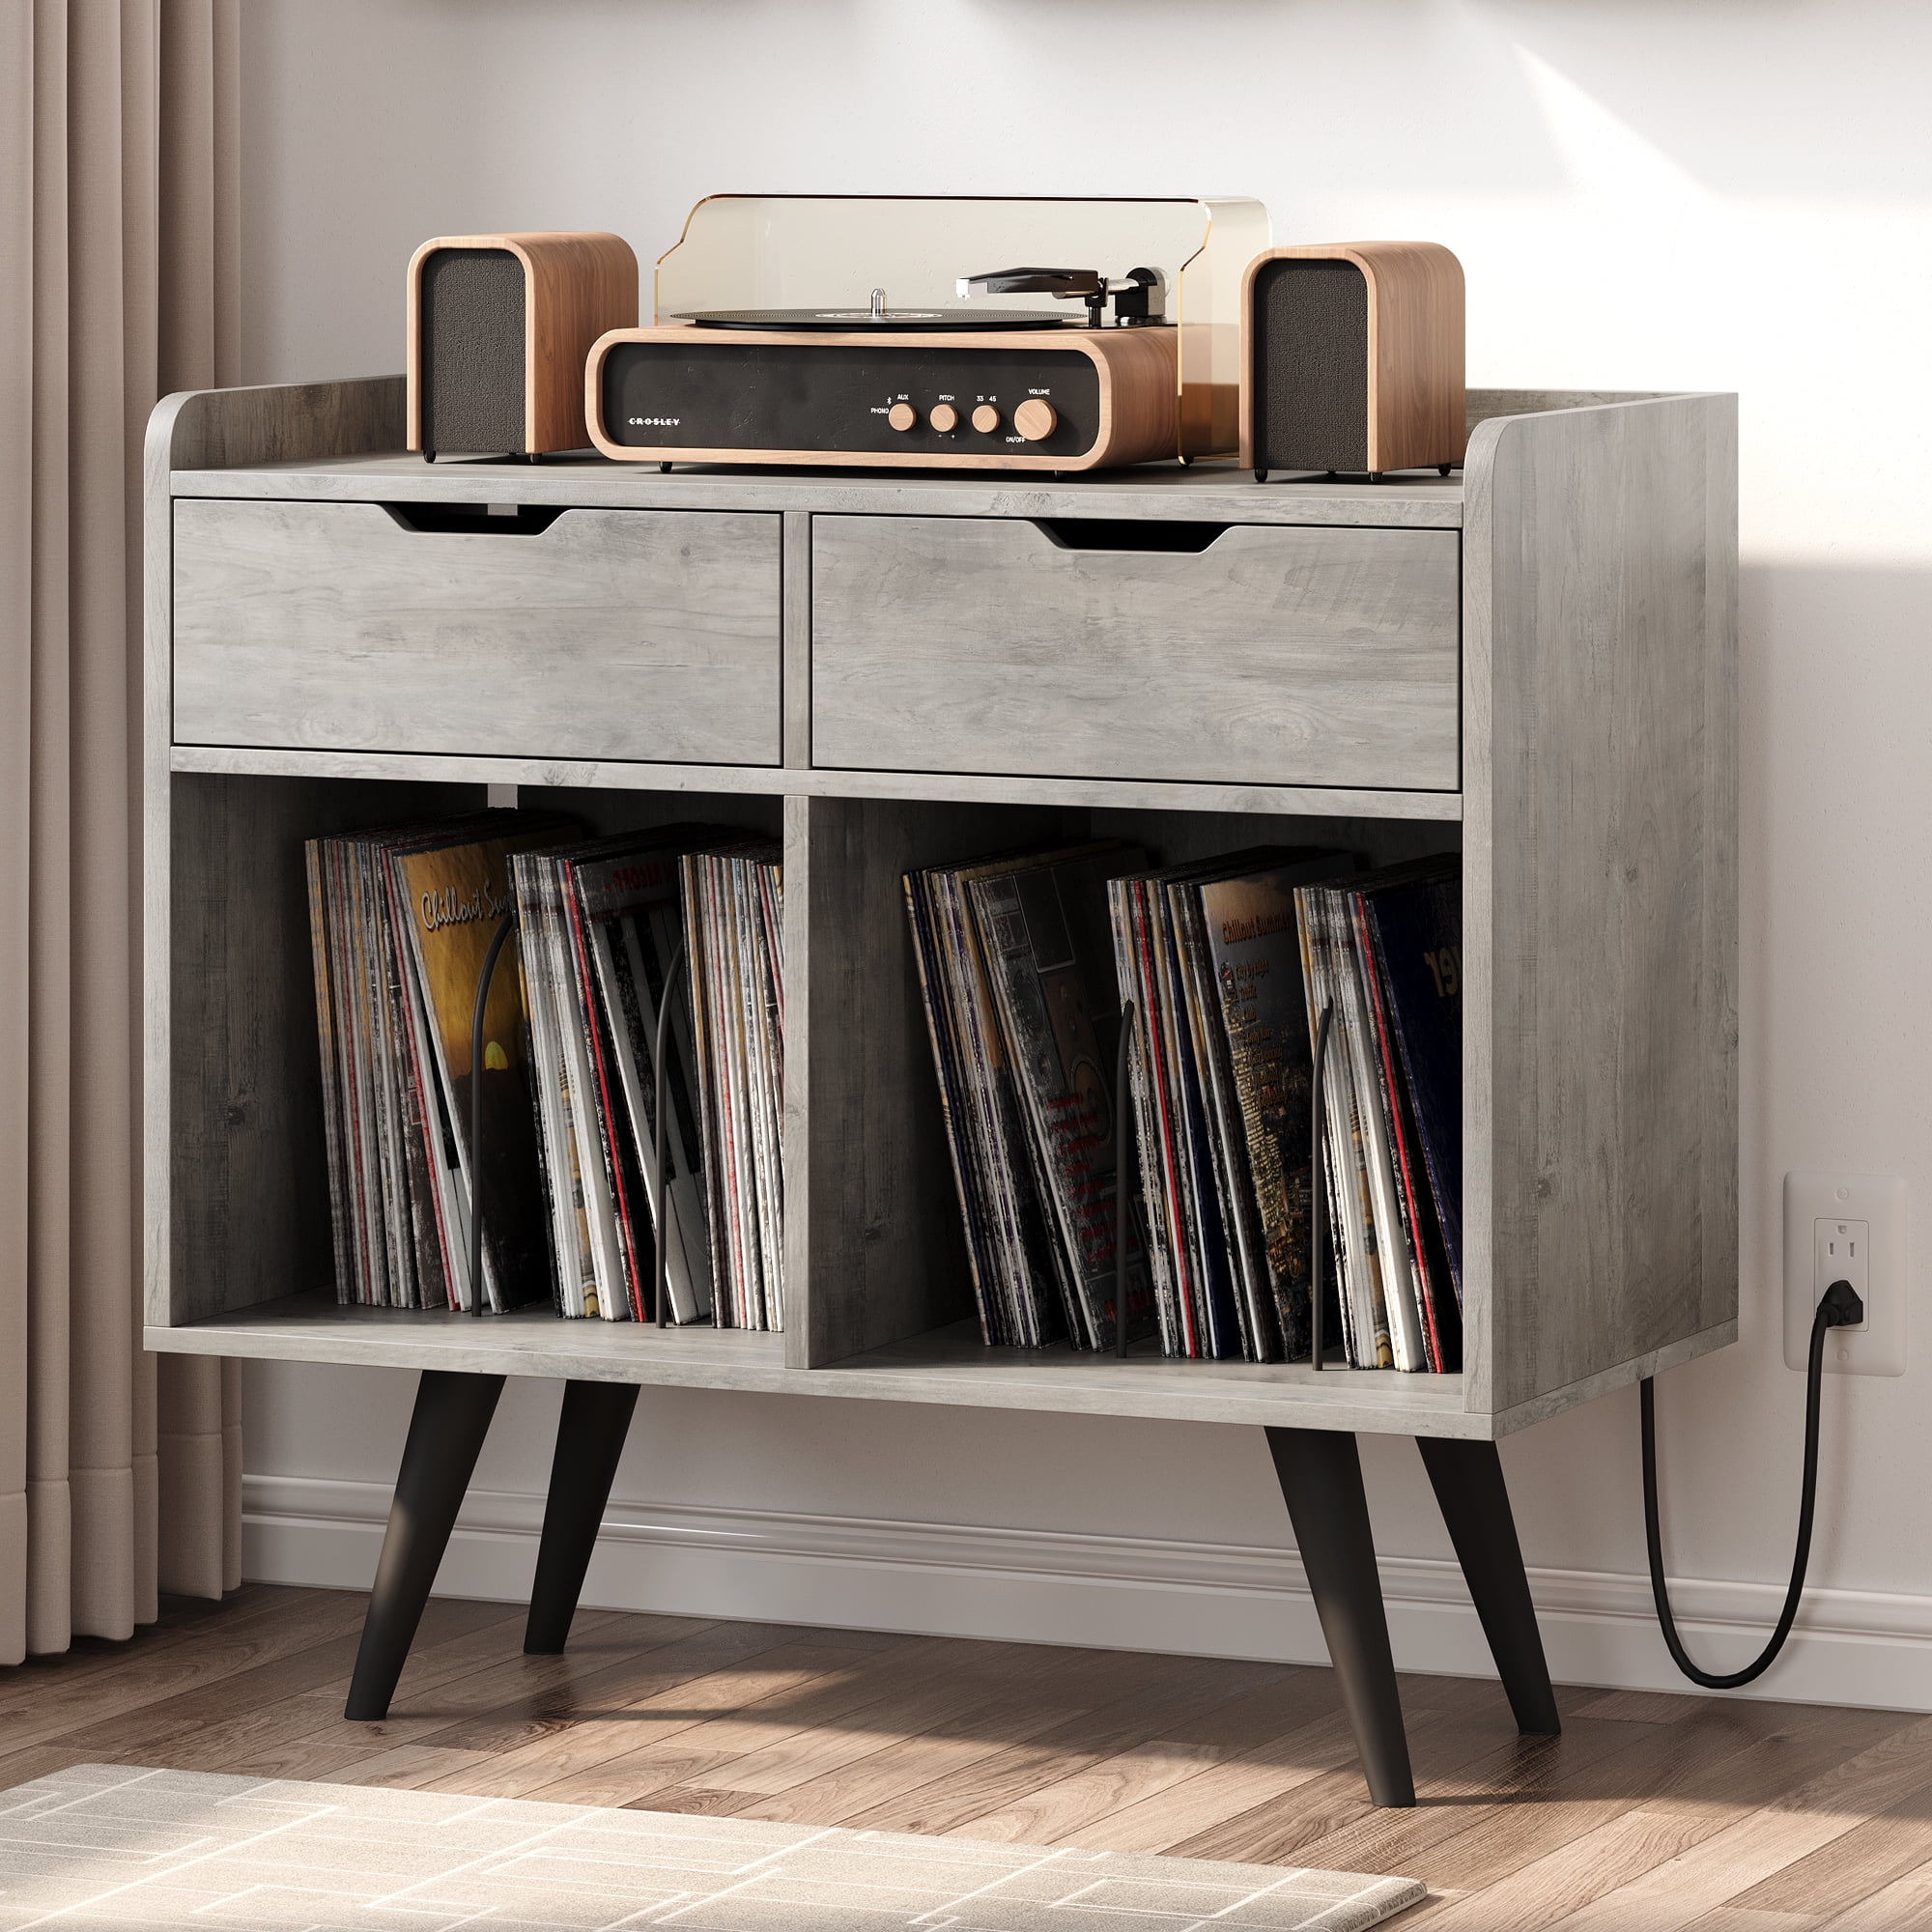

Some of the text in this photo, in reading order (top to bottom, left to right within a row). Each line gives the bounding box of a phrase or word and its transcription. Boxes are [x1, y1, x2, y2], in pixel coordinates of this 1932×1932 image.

[627, 417, 680, 426] CROSLEY
[420, 884, 483, 931] Chillout
[1220, 917, 1256, 944] Chillout
